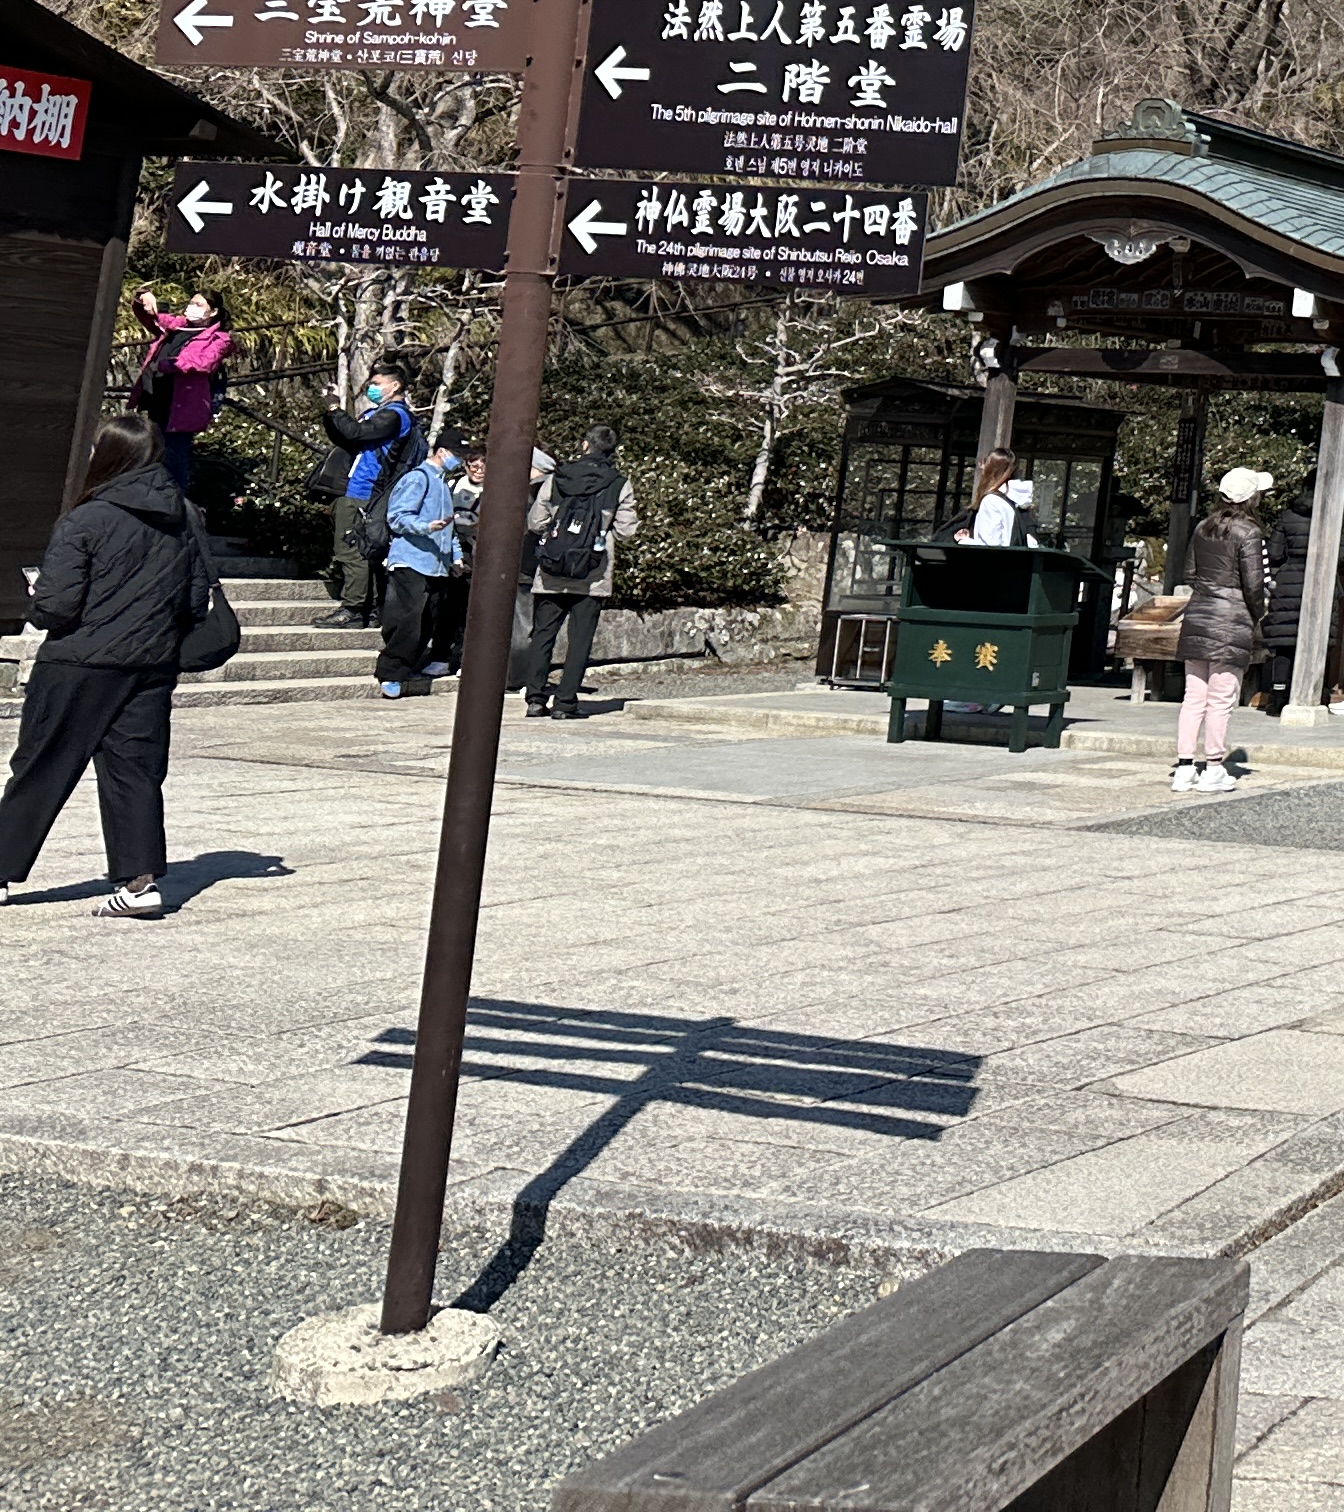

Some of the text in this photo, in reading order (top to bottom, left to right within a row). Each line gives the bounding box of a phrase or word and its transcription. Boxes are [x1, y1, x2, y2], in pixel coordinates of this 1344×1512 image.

[305, 31, 456, 45] Shrine of Sampoh-kohjin
[717, 59, 896, 107] 二階堂
[651, 104, 957, 133] The 5th pilgrimage site of Hohnen-shonin Nikaido-hall
[249, 170, 501, 226] 水掛け観音堂
[635, 184, 918, 248] 神仏霊場大阪二十四番
[309, 222, 426, 241] Hall of Mercy Buddha
[636, 239, 909, 266] The 24th pilgrimage site of Shinbutsu Reijo Osaka
